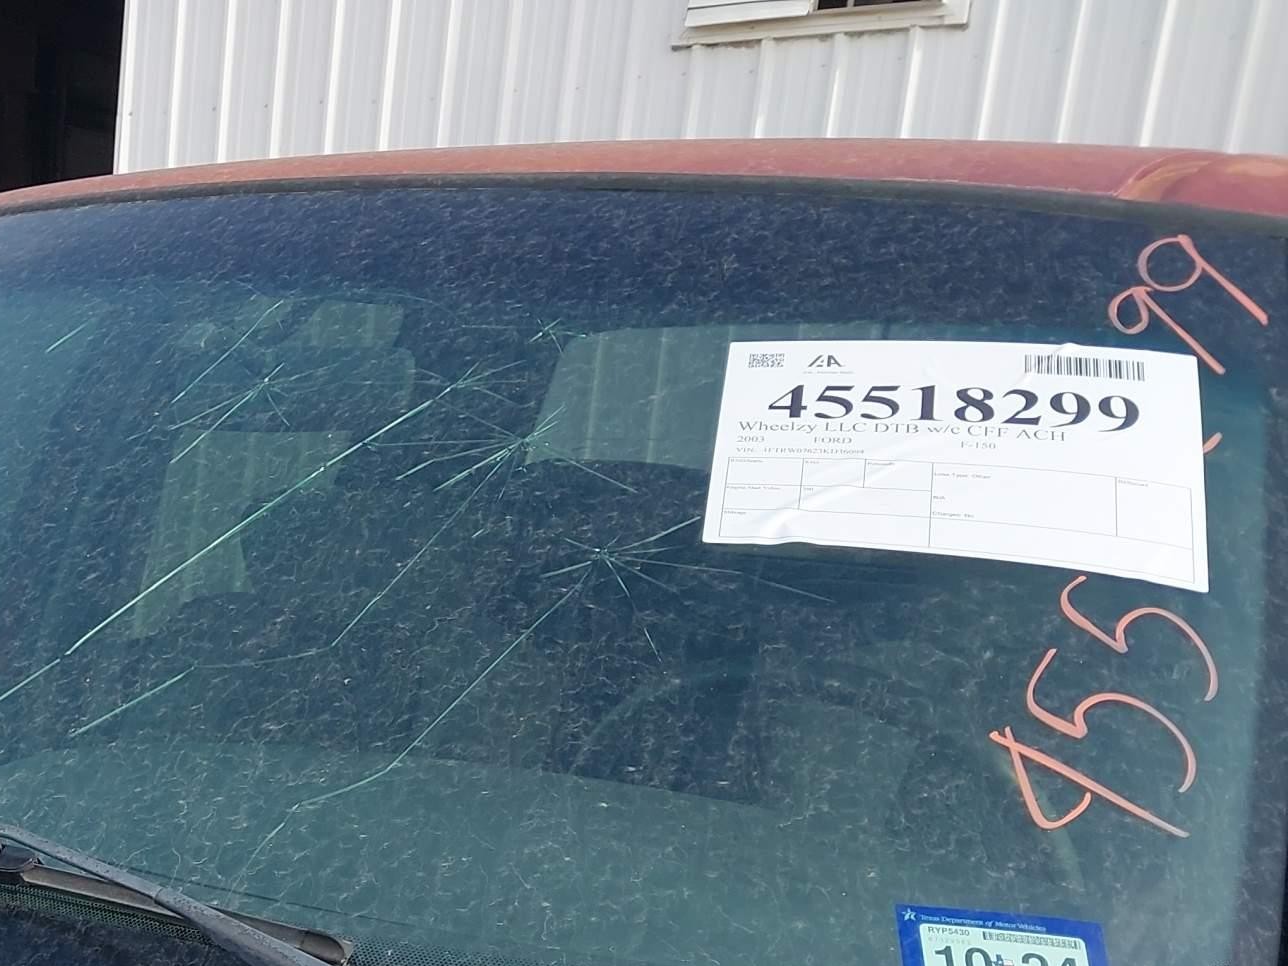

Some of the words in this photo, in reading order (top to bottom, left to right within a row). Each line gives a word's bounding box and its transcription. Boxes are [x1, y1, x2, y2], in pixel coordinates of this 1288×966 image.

[768, 385, 1140, 432] 45518299
[739, 421, 817, 434] Wheelzy
[825, 422, 867, 433] LLC
[874, 422, 919, 434] DTB
[1016, 429, 1065, 441] ACH
[736, 435, 765, 443] 2003
[960, 441, 997, 449] F-150
[941, 916, 984, 927] Department
[995, 921, 1017, 929] Motor
